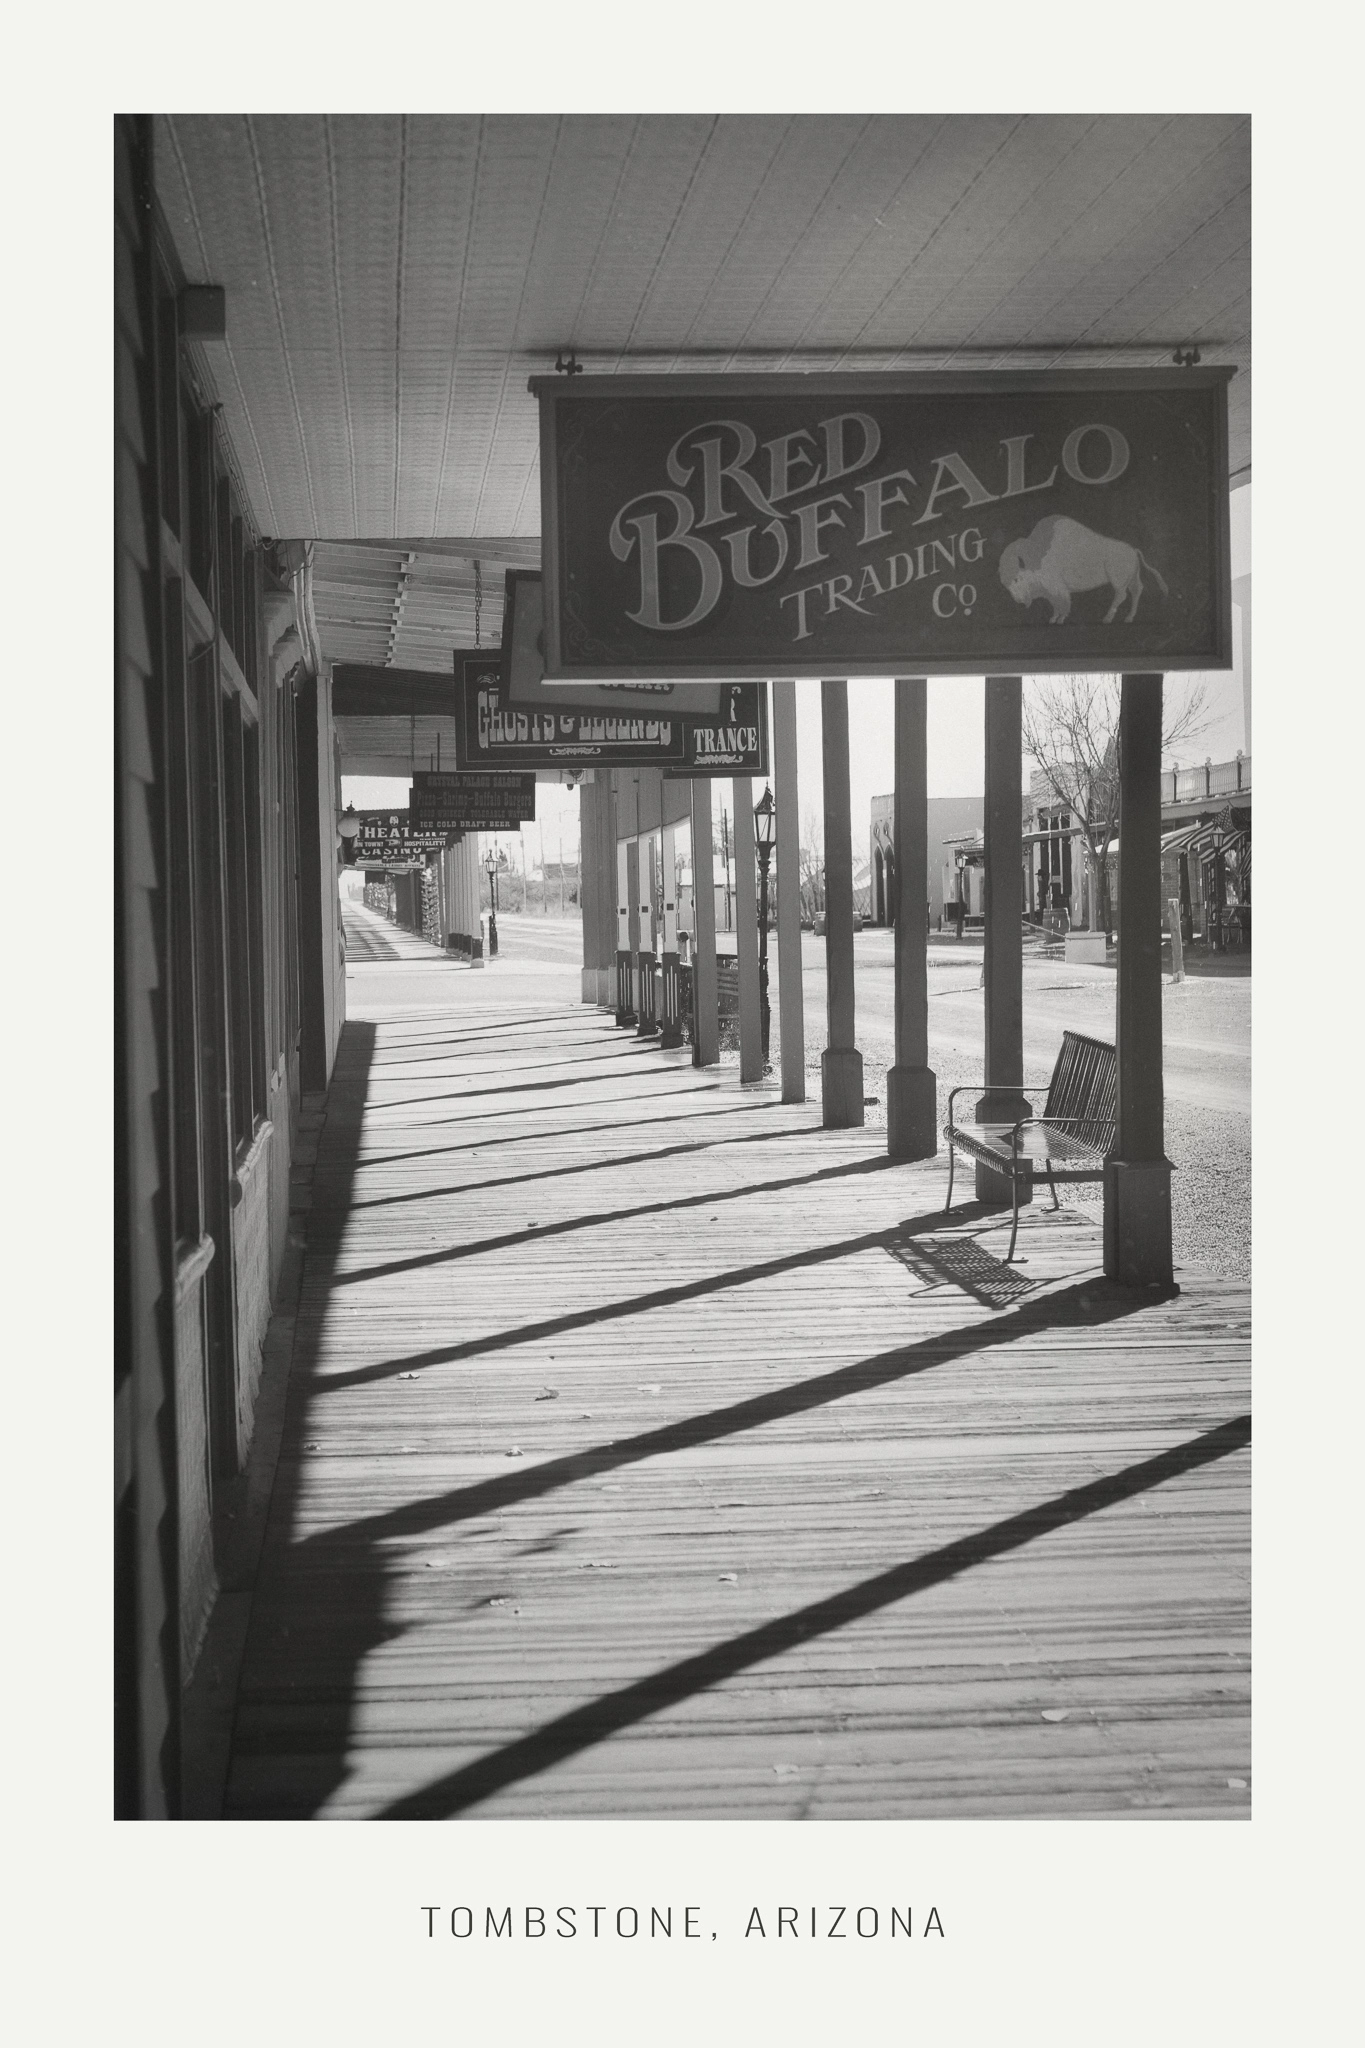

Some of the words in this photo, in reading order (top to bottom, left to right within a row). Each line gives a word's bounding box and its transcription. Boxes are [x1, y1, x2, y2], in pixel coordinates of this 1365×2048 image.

[667, 412, 881, 529] RED
[609, 424, 1130, 630] BUFFALO
[780, 528, 987, 641] TRADING
[693, 727, 757, 753] TRANCE
[493, 776, 522, 788] SALOON
[460, 820, 487, 828] DRAFT
[489, 820, 511, 828] BEER
